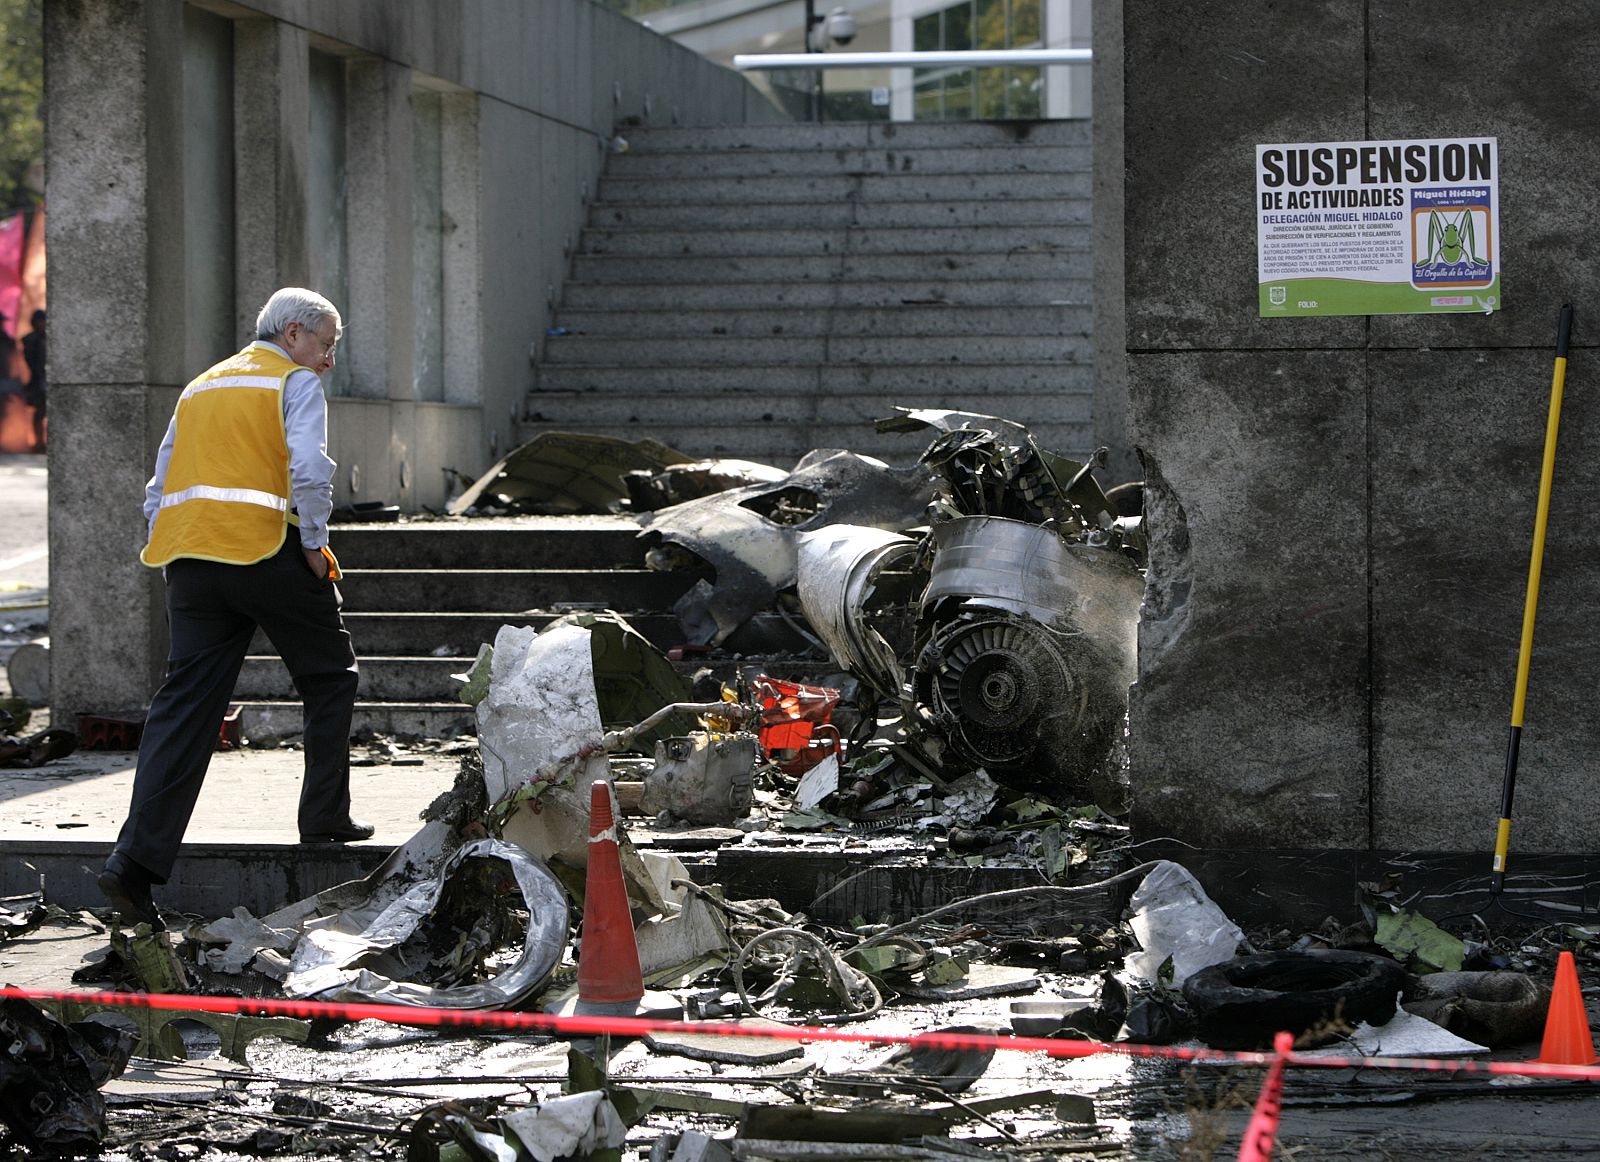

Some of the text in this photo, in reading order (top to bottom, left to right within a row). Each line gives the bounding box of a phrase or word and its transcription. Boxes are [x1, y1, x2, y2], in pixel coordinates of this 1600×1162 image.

[1262, 144, 1491, 188] SUSPENSION
[1262, 188, 1404, 210] DE ACTIVIDADES
[1414, 189, 1487, 199] Miguel Hidalgo
[1263, 211, 1403, 224] DELEGACIÓN MIGUEL HIDALGO
[1416, 267, 1488, 280] El Orgullo de la Capital
